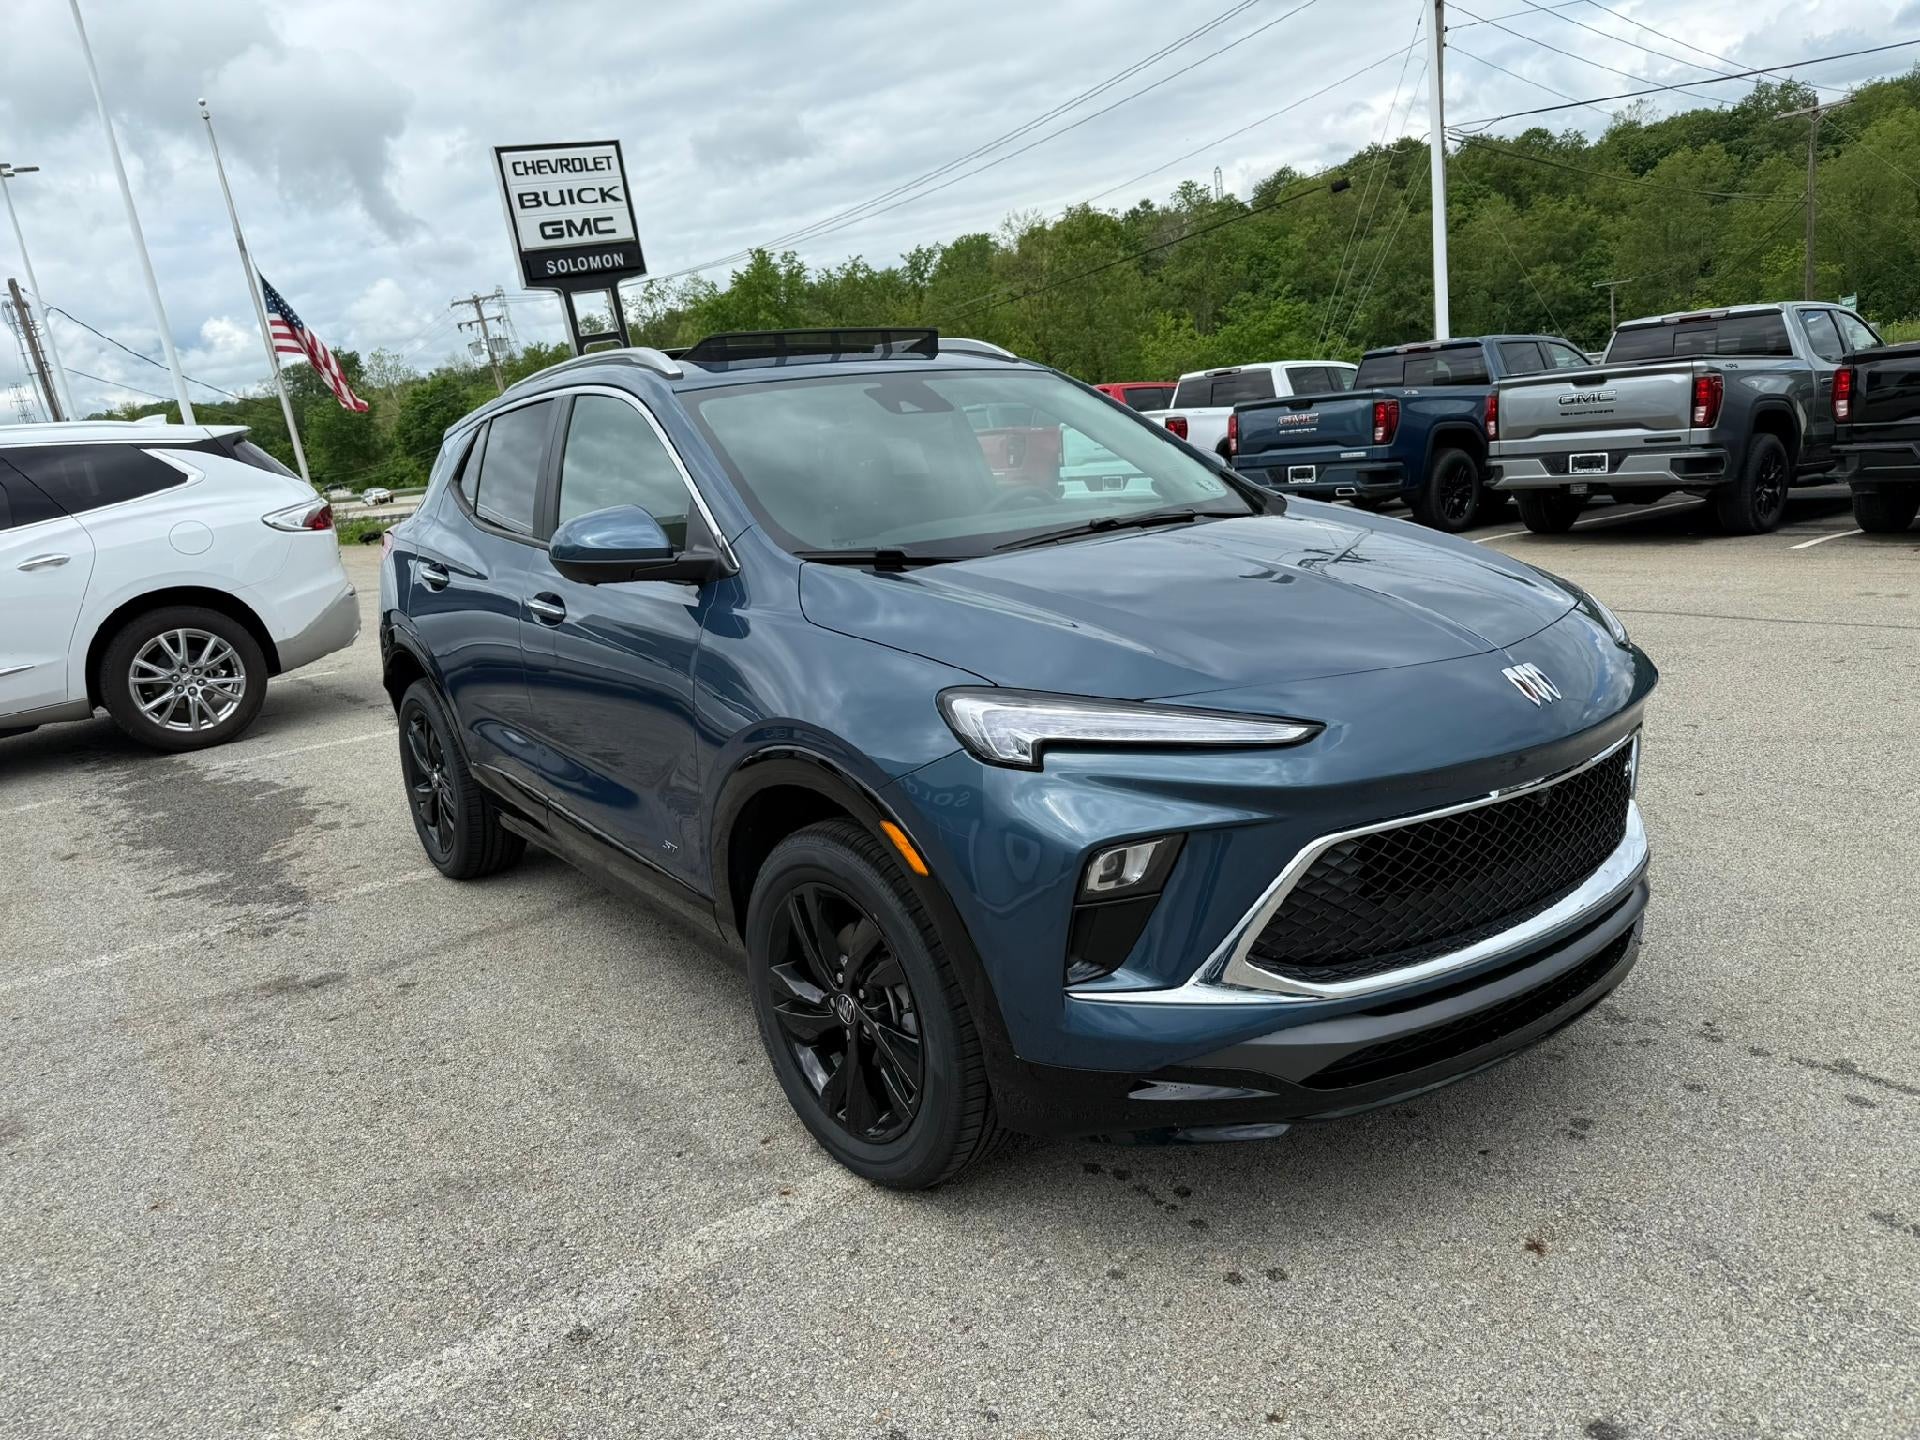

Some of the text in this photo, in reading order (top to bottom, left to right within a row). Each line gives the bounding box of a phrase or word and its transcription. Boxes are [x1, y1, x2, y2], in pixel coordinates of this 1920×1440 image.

[511, 156, 612, 176] CHEVROLET
[517, 185, 623, 210] BUICK
[539, 216, 617, 240] GMC
[546, 252, 625, 275] SOLOMON
[1558, 389, 1617, 407] GMC
